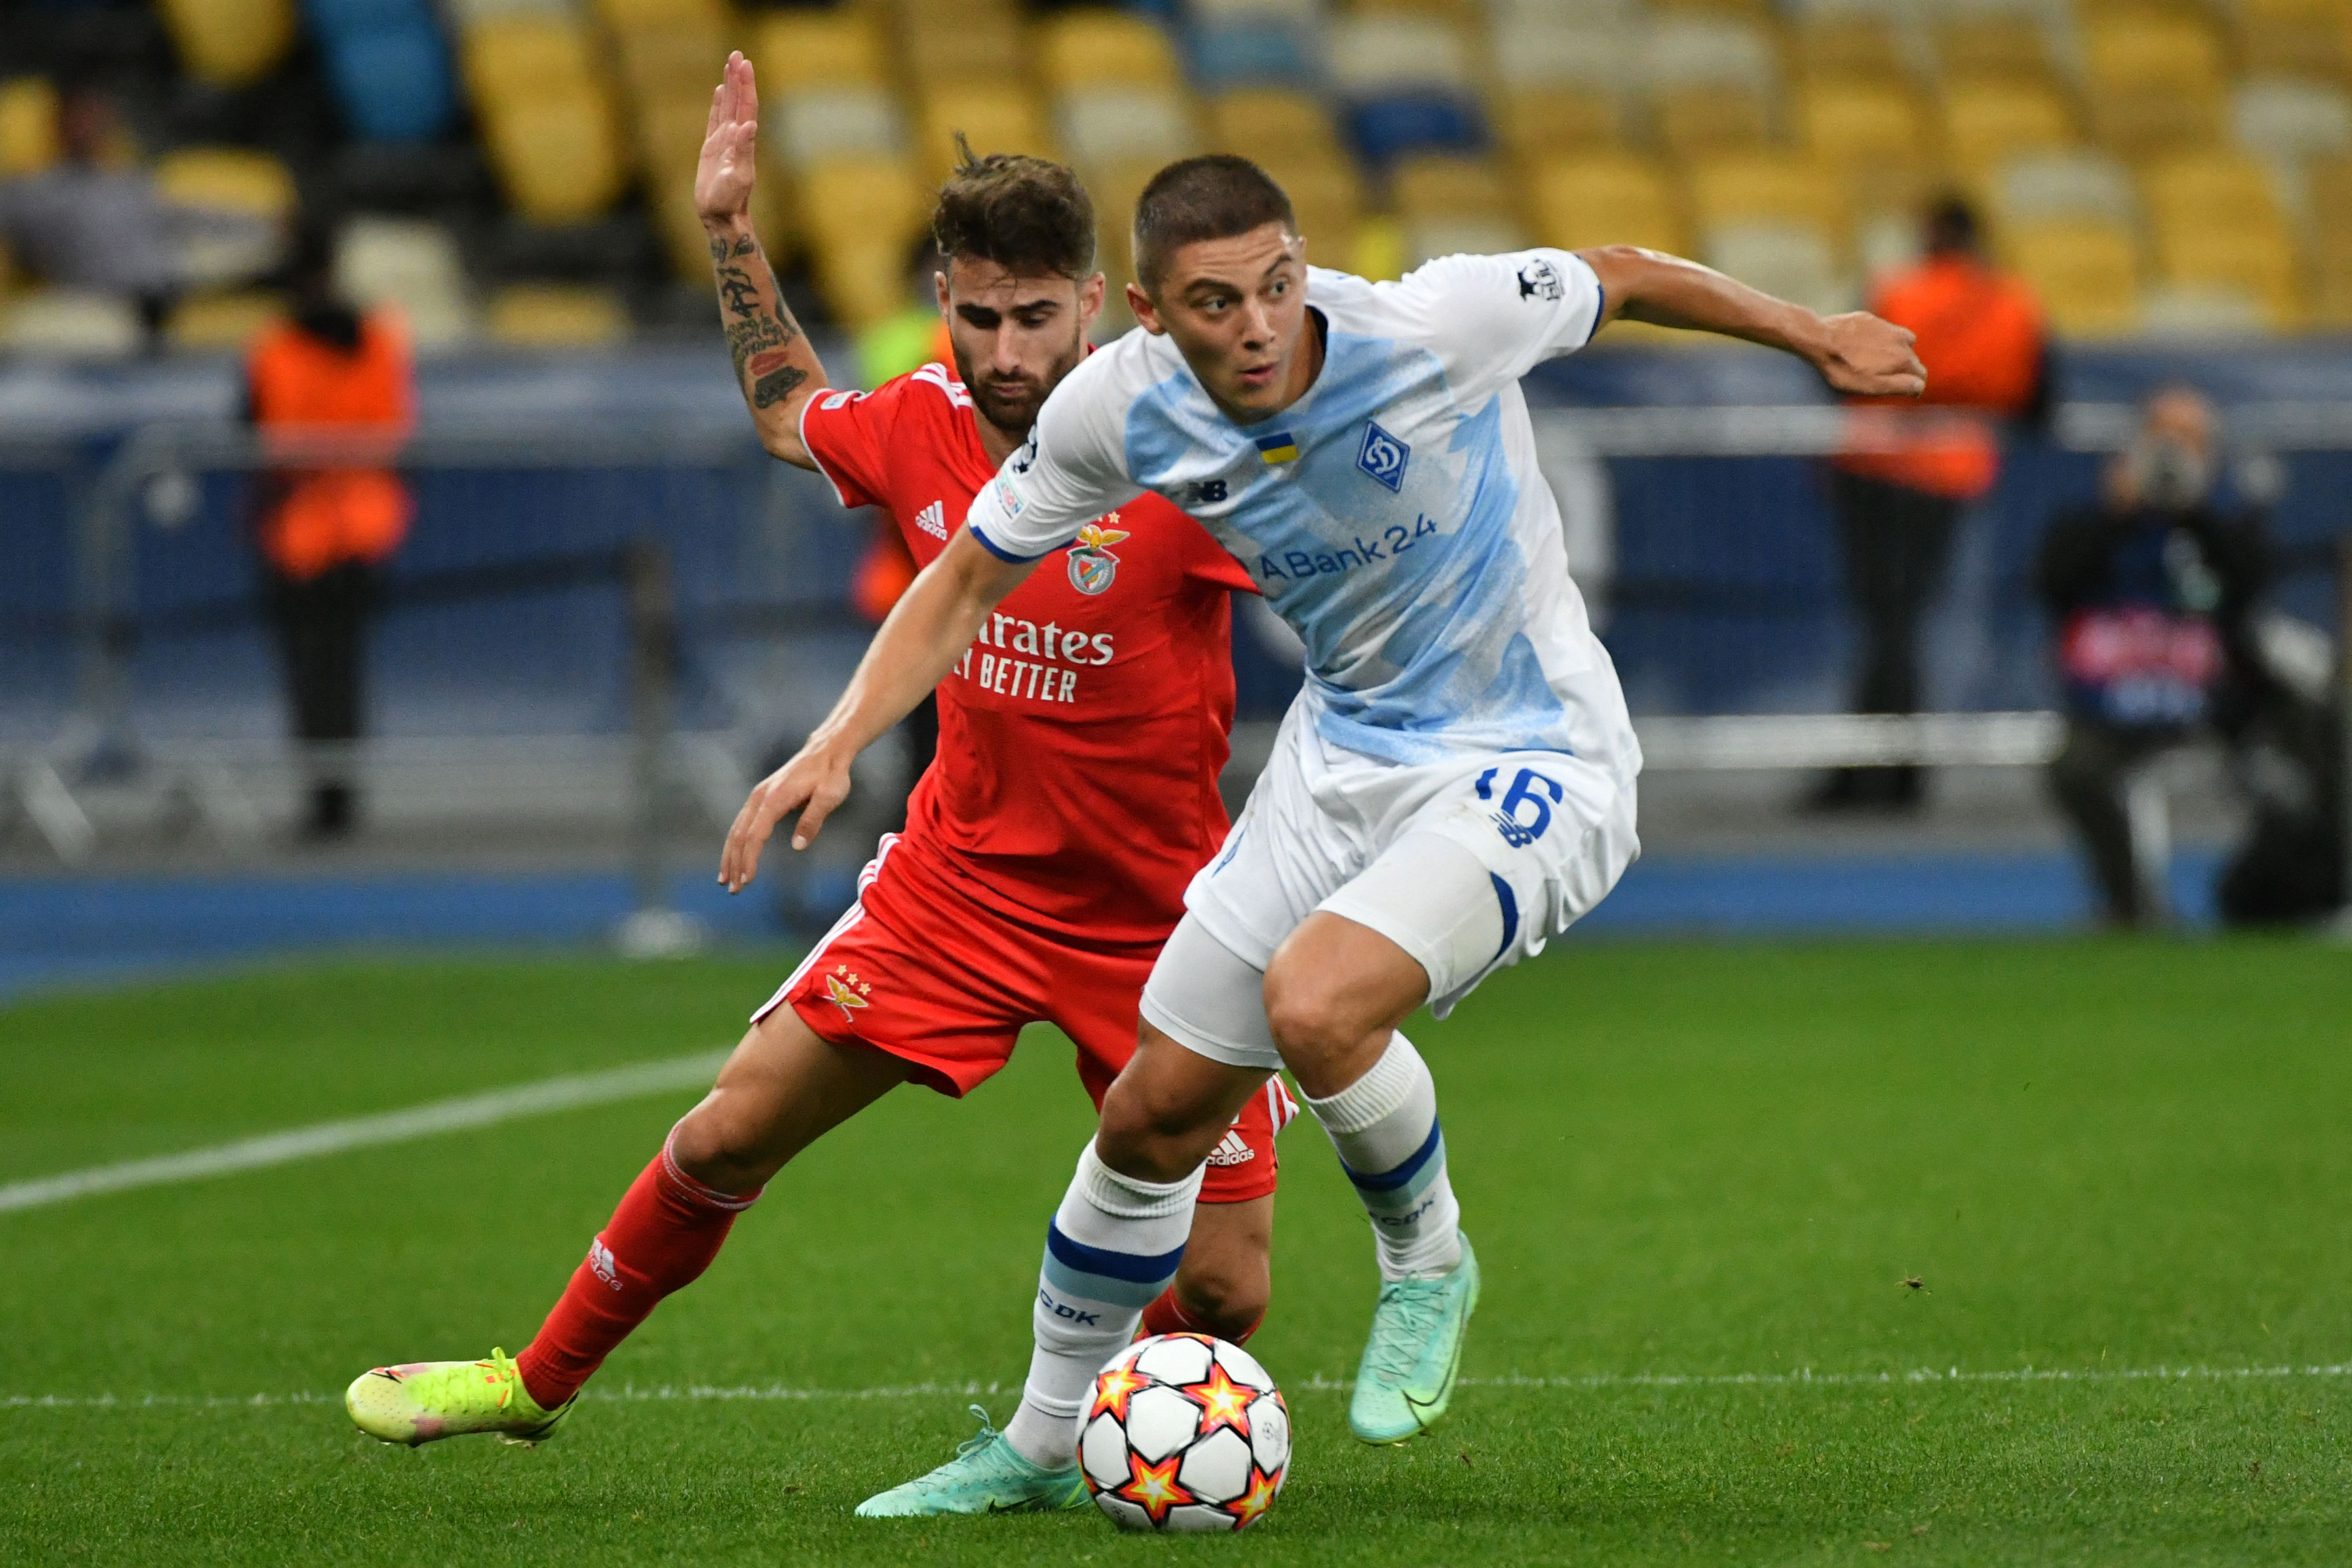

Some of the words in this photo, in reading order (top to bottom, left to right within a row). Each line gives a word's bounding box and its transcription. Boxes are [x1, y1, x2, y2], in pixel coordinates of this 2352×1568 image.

[978, 612, 1114, 666] rates
[979, 653, 1077, 703] BETTER
[1205, 1149, 1255, 1165] adidas
